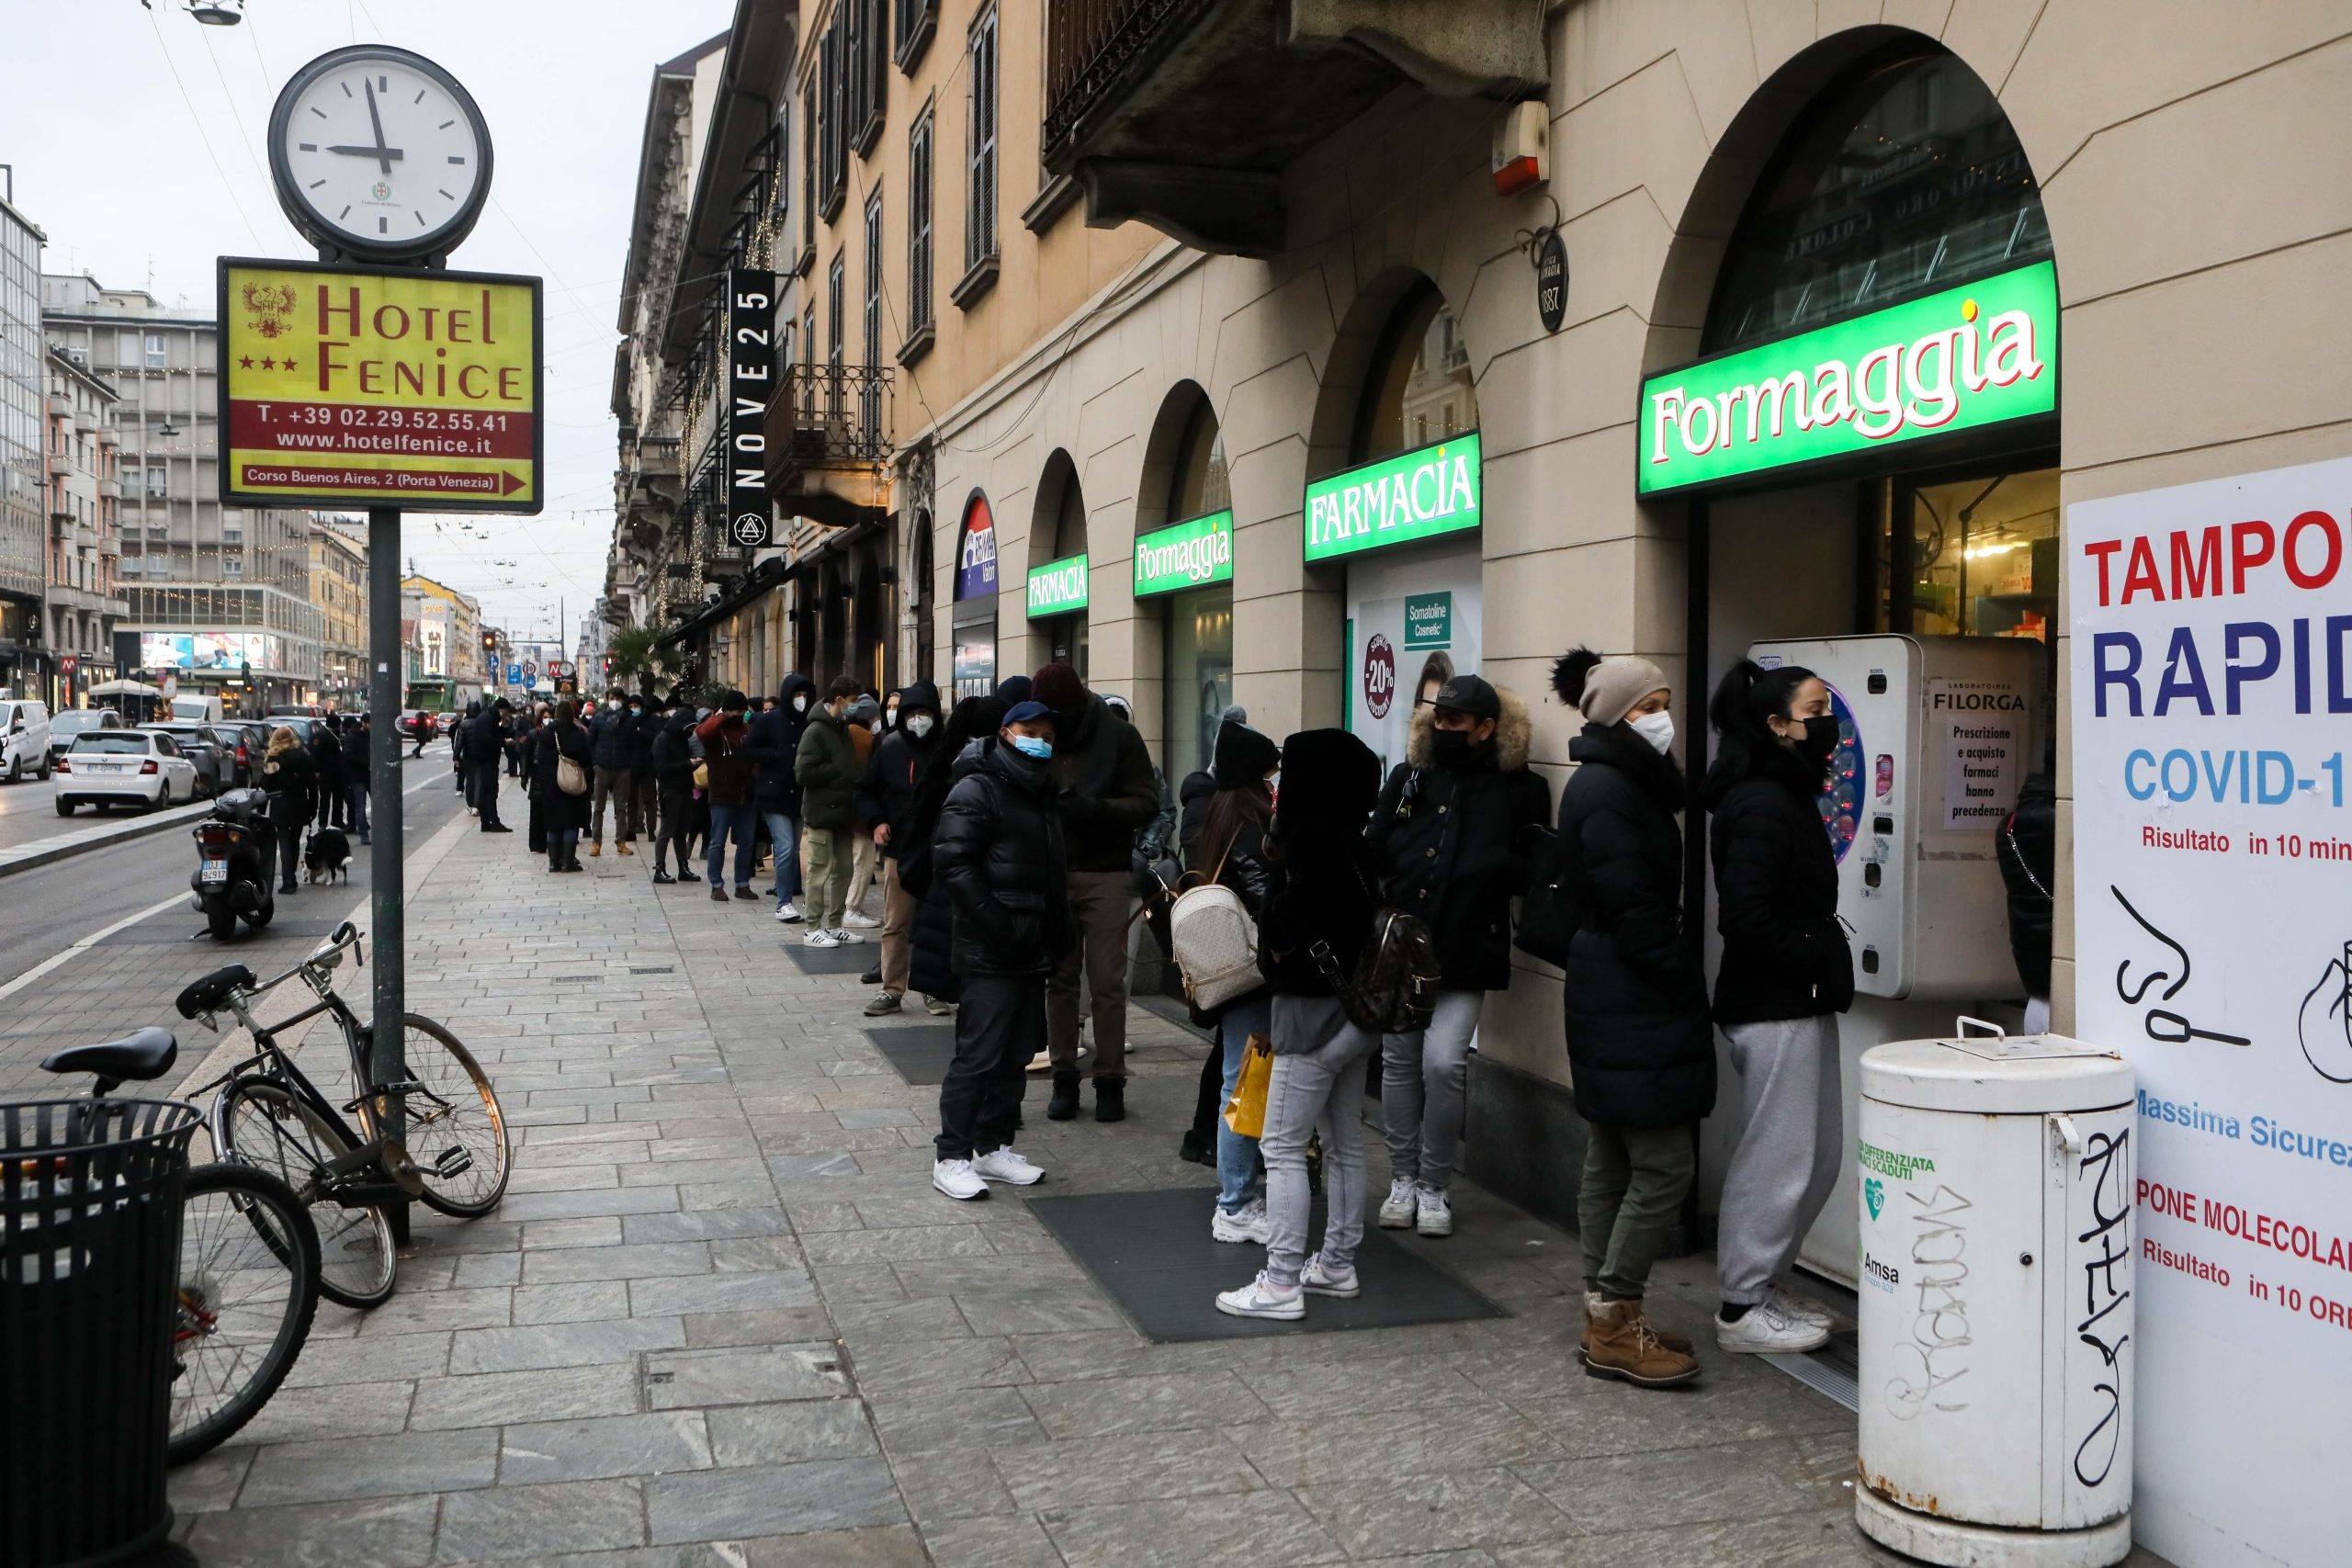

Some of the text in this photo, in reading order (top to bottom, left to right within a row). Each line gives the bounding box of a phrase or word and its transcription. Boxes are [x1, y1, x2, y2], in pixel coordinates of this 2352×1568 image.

[735, 292, 768, 489] NOVE25
[1651, 299, 2044, 465] Formaggia
[257, 404, 507, 432] T. +39 02.29.52.55.41
[277, 432, 492, 454] www.hotelfenice.it
[247, 468, 494, 490] Corso Buenos Aires, 2 (Porta Venezia)
[1309, 446, 1477, 547] FARMACIA
[1136, 521, 1231, 582] Formaggia
[2085, 507, 2352, 607] TAMPO
[1028, 558, 1088, 608] FARMACIA
[1409, 604, 1446, 621] Somatoline
[1365, 660, 1394, 694] -20%
[1367, 695, 1390, 717] DISCOUNT
[1934, 694, 2025, 711] FILORGA
[1953, 726, 2011, 739] Prescrizione
[1958, 746, 2006, 761] e acquisto
[1963, 764, 1999, 778] farmaci
[1965, 784, 1995, 797] hanno
[1952, 803, 2006, 819] precedenza
[2143, 825, 2230, 853] Risultato
[2249, 832, 2268, 855] in
[2277, 834, 2301, 858] 10
[1865, 1143, 1935, 1173] DIFFERENZIATA
[1872, 1156, 1913, 1181] SCADUTI
[2204, 1198, 2352, 1273] MOLECOLA
[1864, 1252, 1899, 1284] Amsa
[2143, 1238, 2231, 1287] Risultato
[2249, 1274, 2268, 1302] in
[2277, 1284, 2301, 1312] 10
